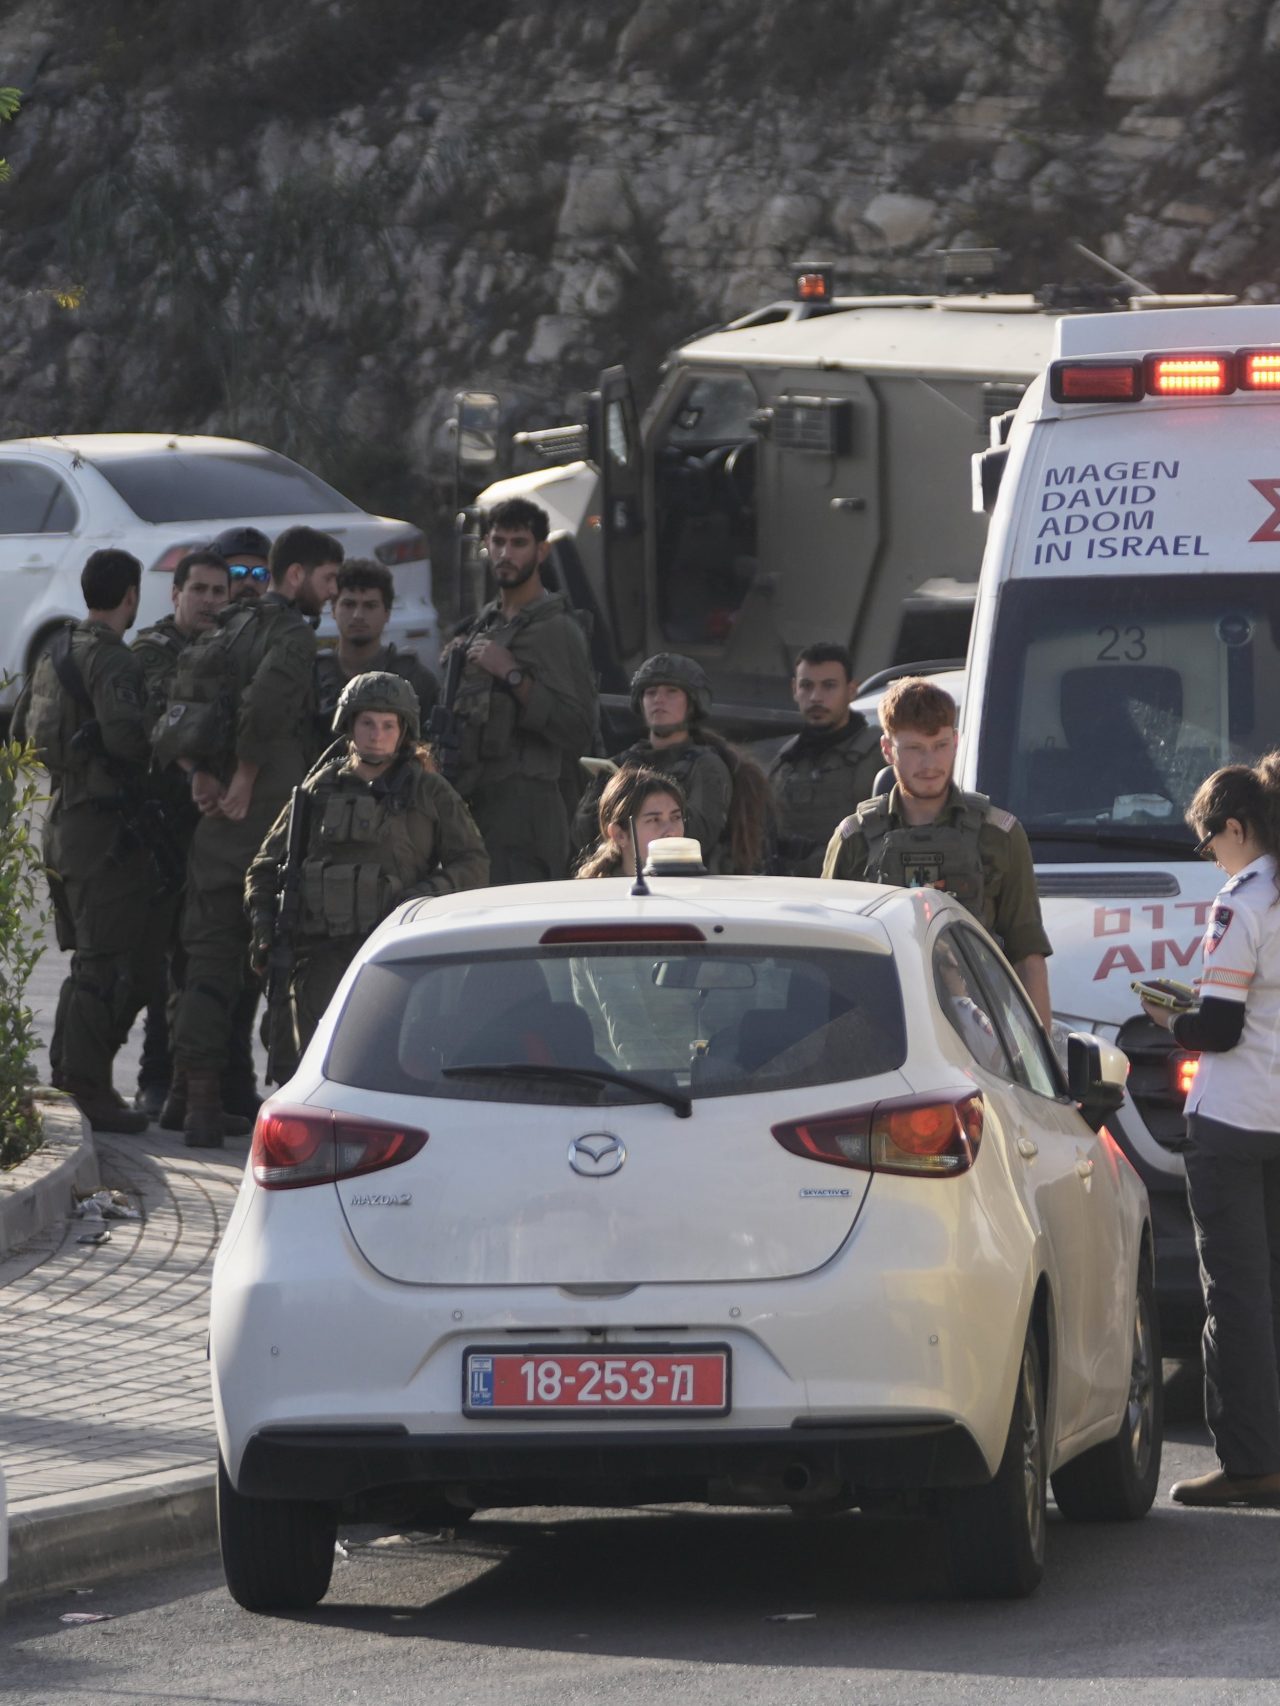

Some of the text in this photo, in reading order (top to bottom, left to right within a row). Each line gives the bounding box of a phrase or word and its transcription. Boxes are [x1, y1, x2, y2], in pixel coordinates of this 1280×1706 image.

[1044, 460, 1180, 488] MAGEN
[1041, 485, 1156, 513] DAVID
[1037, 510, 1155, 539] ADOM
[1033, 535, 1210, 566] IN ISRAEL
[1096, 625, 1148, 661] 23
[473, 1371, 489, 1392] IL
